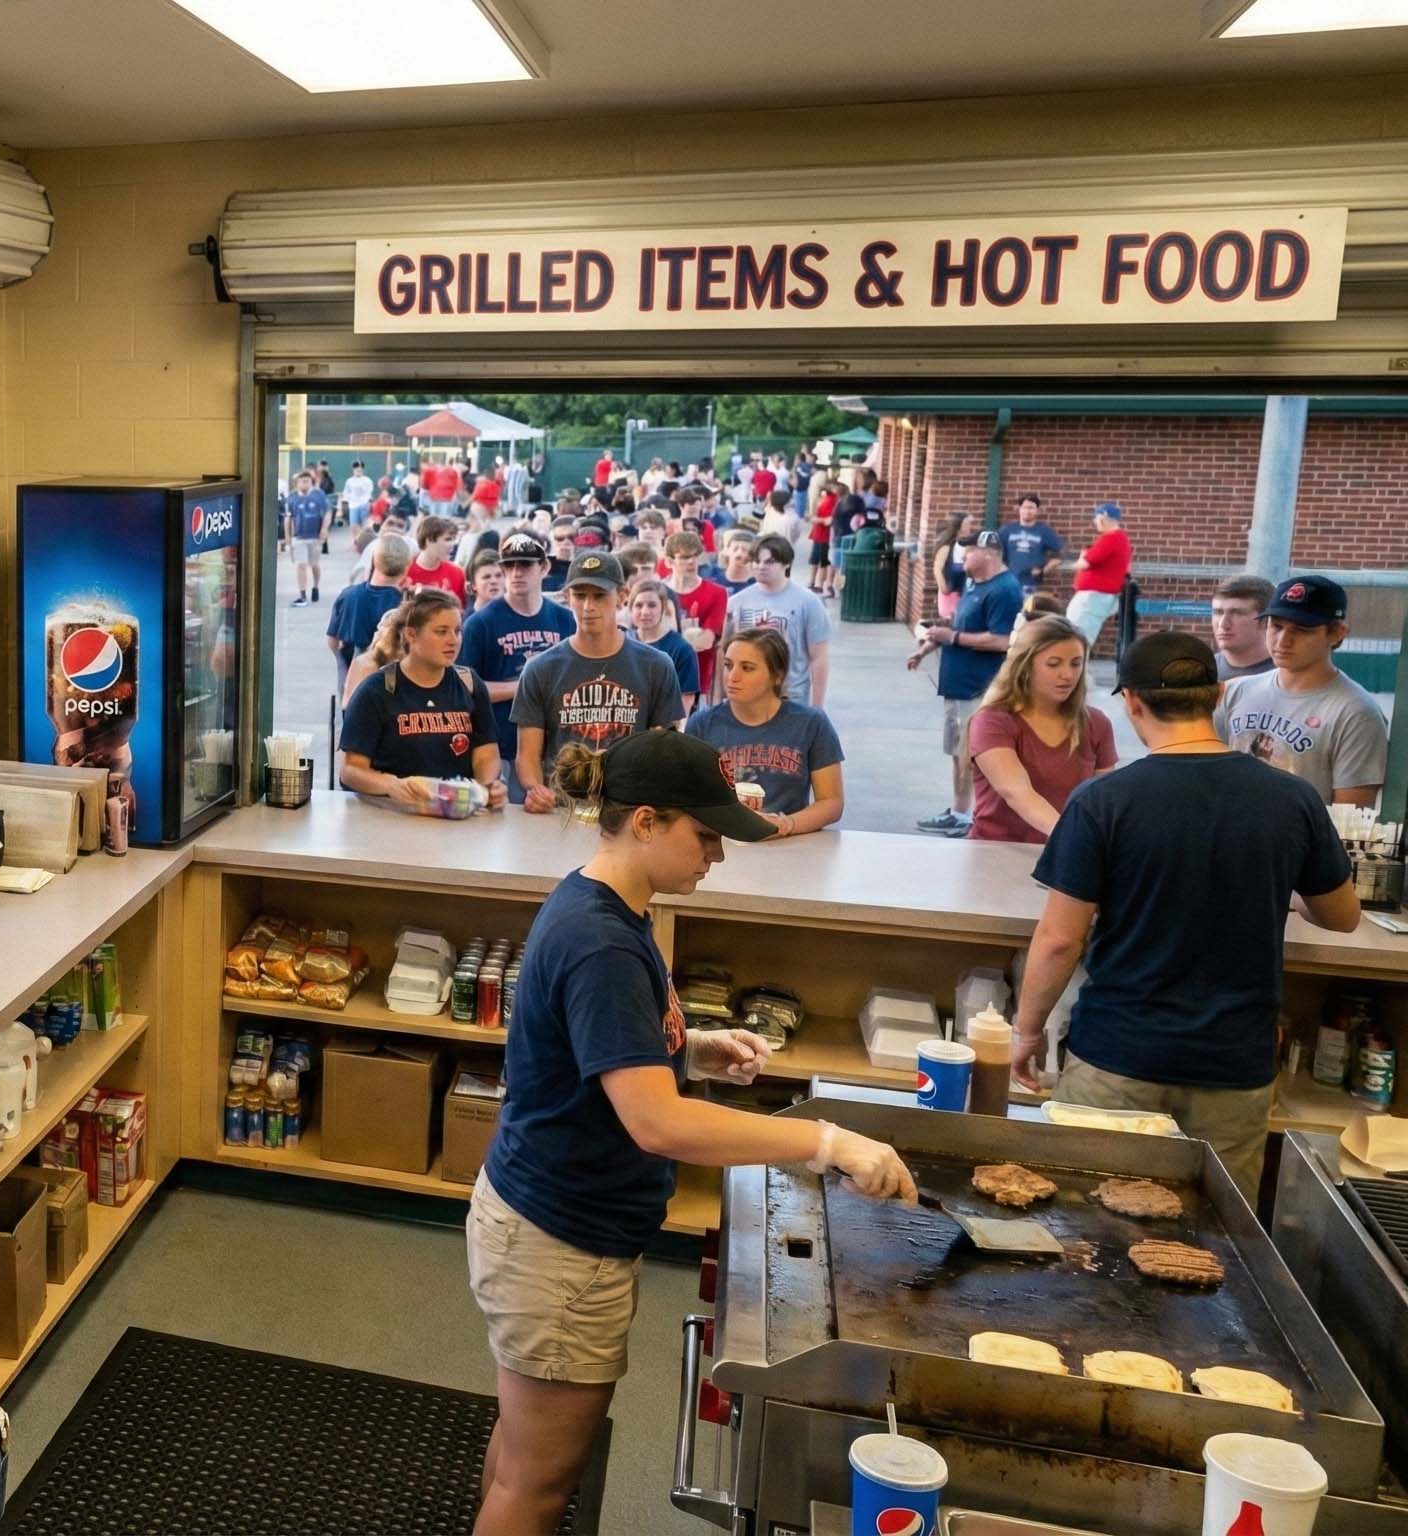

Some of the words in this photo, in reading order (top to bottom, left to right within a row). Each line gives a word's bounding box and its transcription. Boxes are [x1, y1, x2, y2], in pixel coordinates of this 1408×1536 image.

[378, 250, 614, 316] GRILLED
[639, 242, 829, 311] ITEMS
[854, 241, 903, 308] &
[931, 234, 1078, 308] HOT
[1100, 229, 1310, 305] FOOD
[205, 505, 233, 539] pepsi
[65, 698, 119, 718] pepsi
